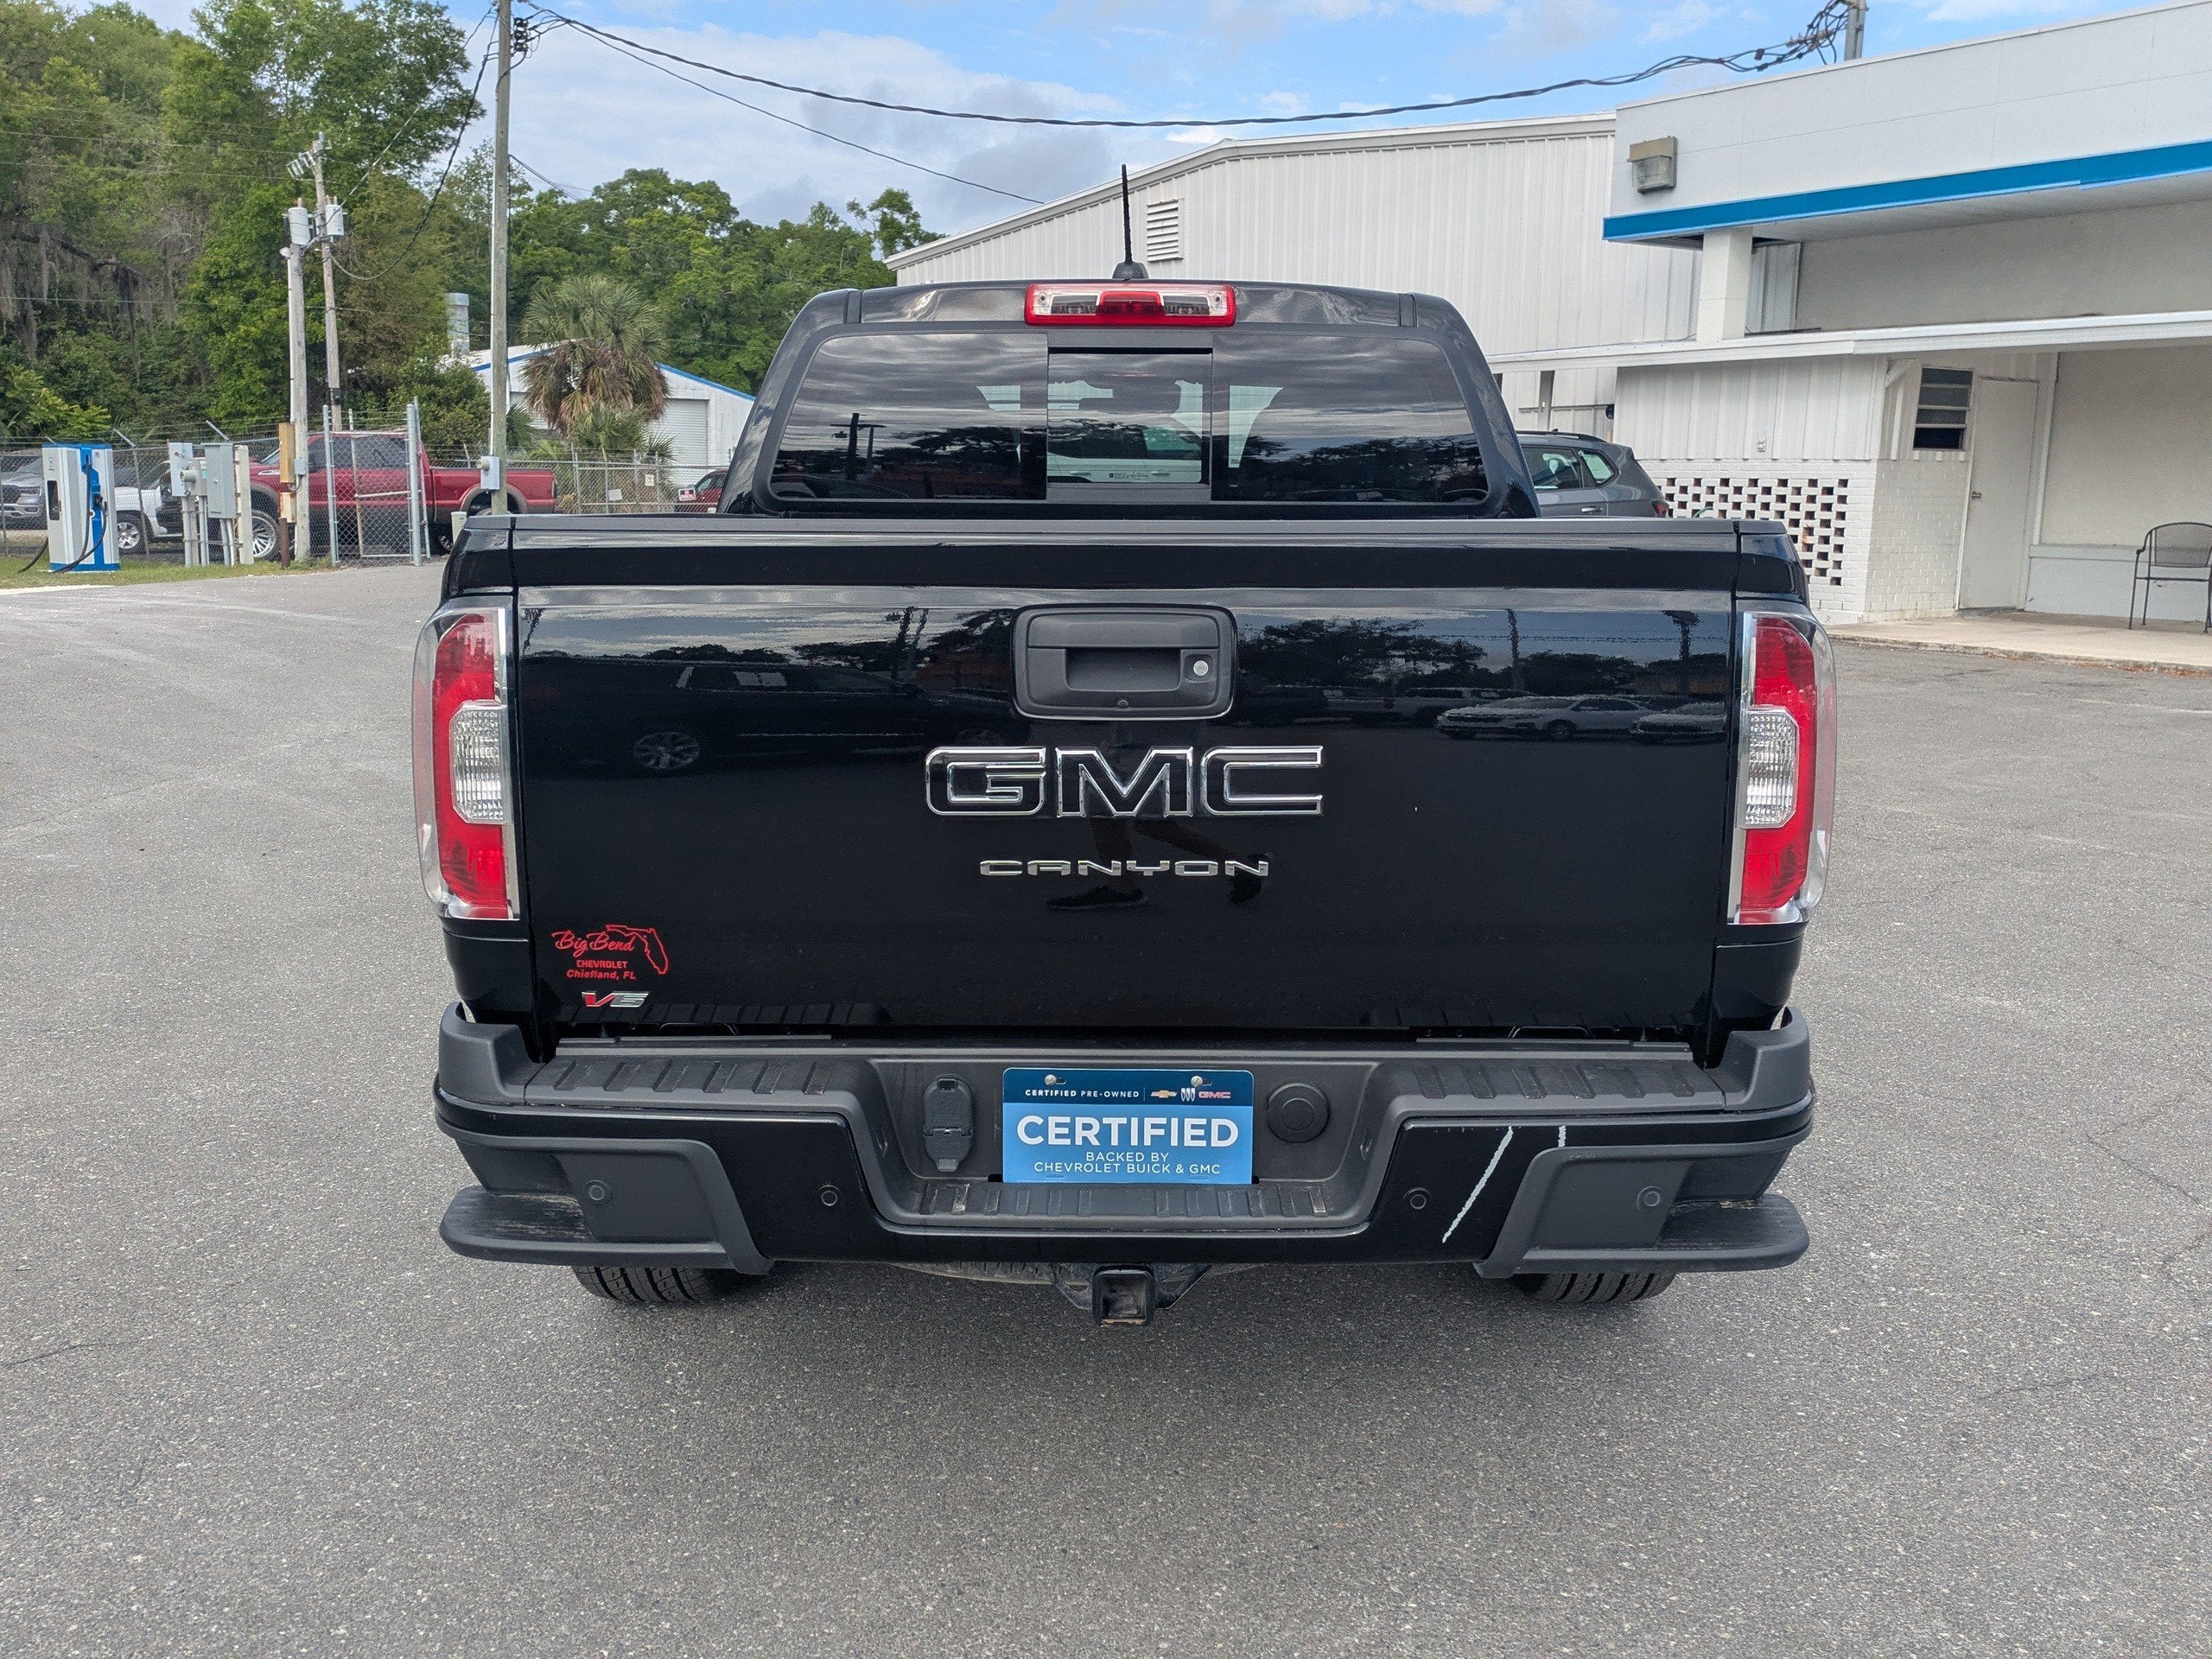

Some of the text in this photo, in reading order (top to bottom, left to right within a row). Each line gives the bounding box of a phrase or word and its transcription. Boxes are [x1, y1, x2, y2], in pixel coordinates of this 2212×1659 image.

[925, 745, 1324, 818] GMC
[980, 860, 1269, 877] CANYON
[551, 929, 637, 957] Big Bend
[575, 959, 628, 969] CHEVROLET
[566, 969, 637, 981] Chiefland, FL
[582, 991, 650, 1007] V6
[1025, 1089, 1077, 1097] CERTIFIED
[1016, 1115, 1239, 1147] CERTIFIED
[1085, 1152, 1169, 1162] BACKED BY
[1034, 1161, 1221, 1175] CHEVROLET BUICK & GMC
